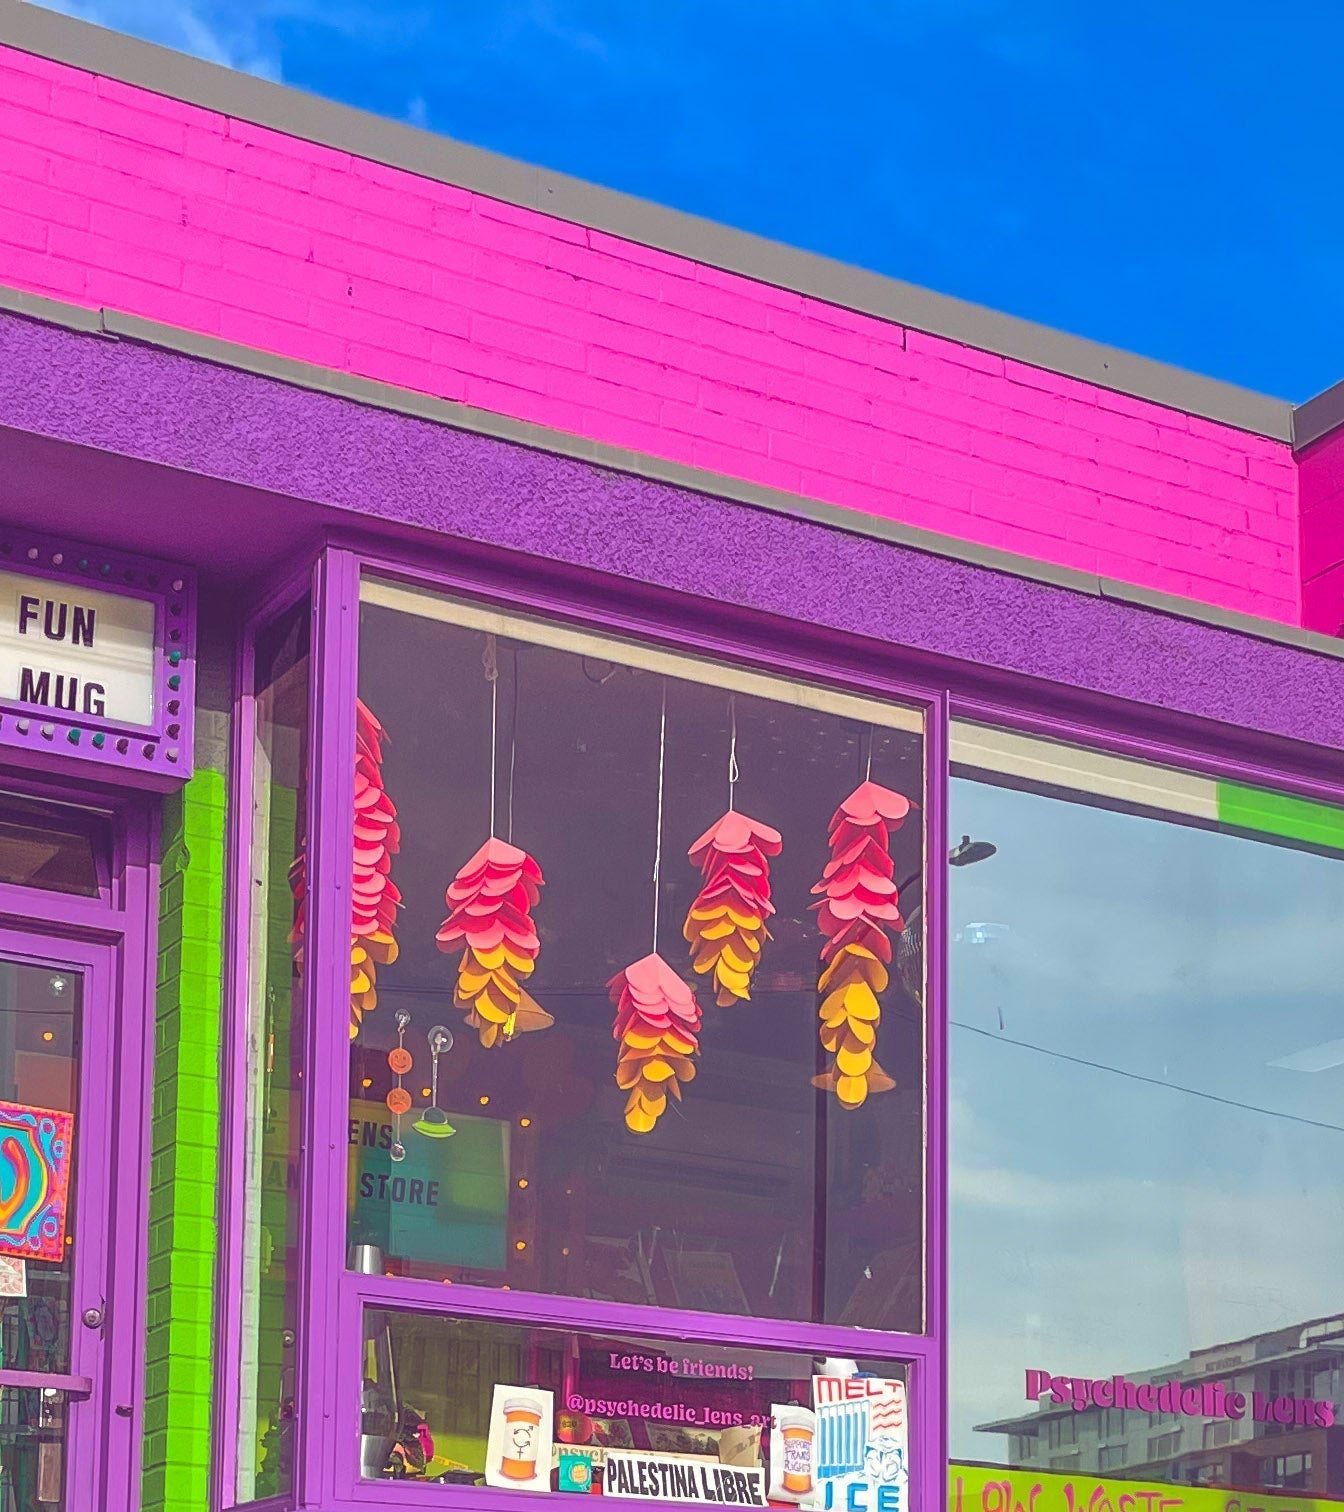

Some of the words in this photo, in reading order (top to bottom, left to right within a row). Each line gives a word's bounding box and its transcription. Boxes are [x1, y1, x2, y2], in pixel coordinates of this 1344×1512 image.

[19, 596, 96, 648] FUN
[20, 668, 106, 718] MUG
[347, 1119, 393, 1150] ENS
[359, 1172, 440, 1207] STORE
[609, 1353, 654, 1372] Let's
[656, 1356, 679, 1374] be
[683, 1359, 754, 1381] friends!
[817, 1376, 902, 1404] MELT
[1024, 1369, 1246, 1420] Psychedelic
[1252, 1390, 1335, 1428] Lens
[566, 1394, 777, 1430] @psychedelic_lens_art
[607, 1455, 700, 1499] PALESTINA
[700, 1467, 764, 1506] LIBRE
